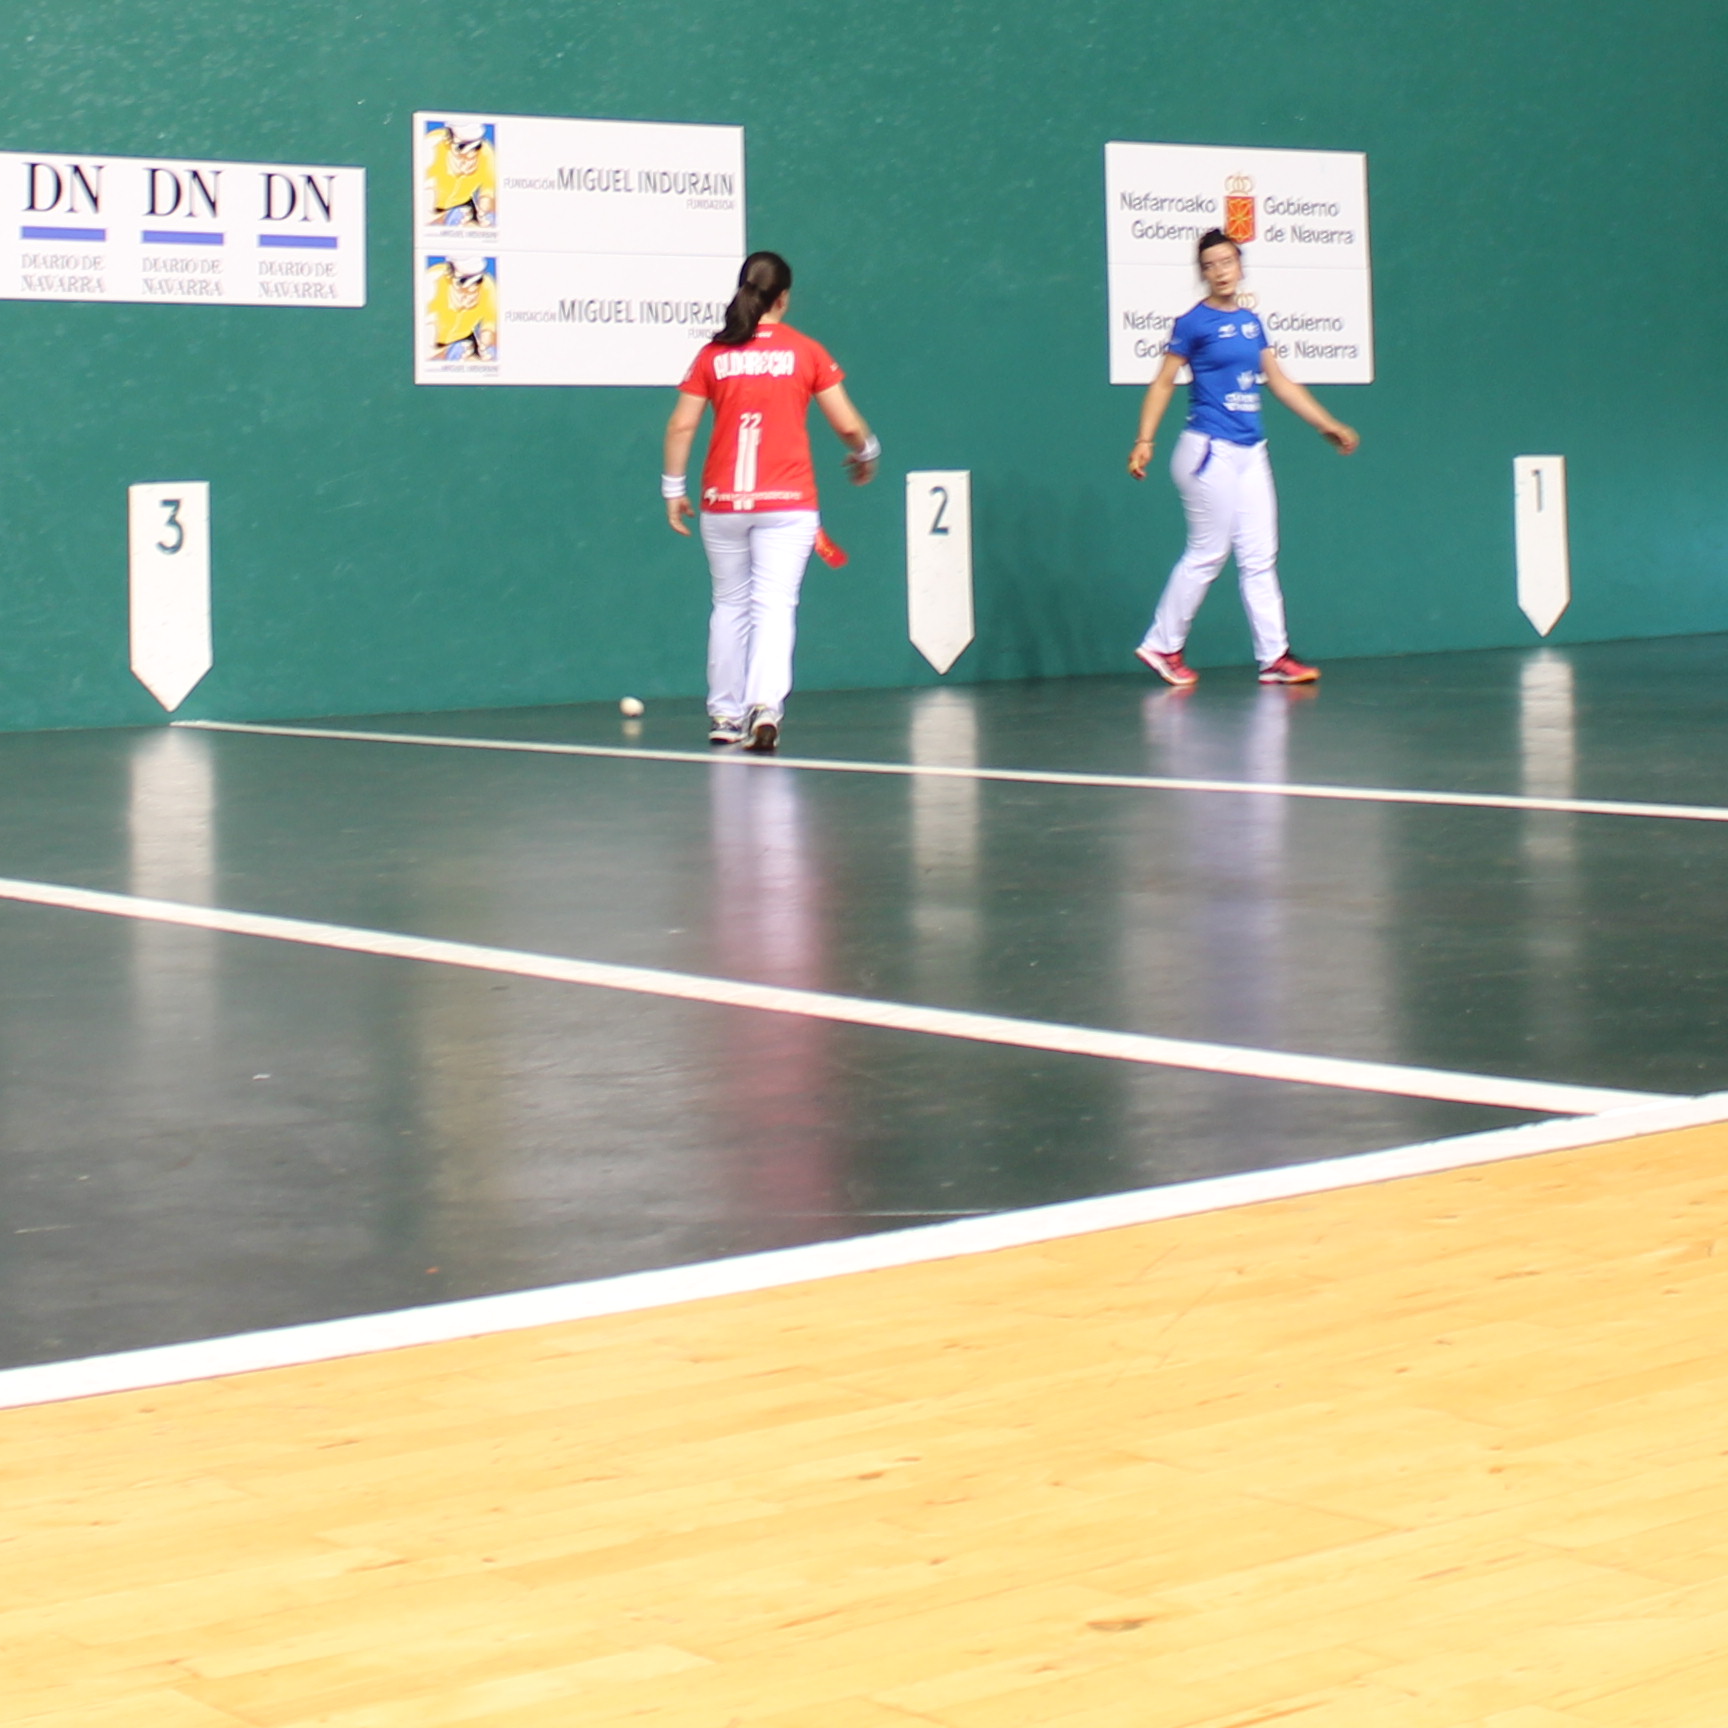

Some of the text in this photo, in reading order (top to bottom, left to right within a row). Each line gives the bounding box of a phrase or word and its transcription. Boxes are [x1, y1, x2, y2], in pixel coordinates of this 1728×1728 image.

[22, 161, 106, 213] DN
[142, 167, 224, 218] DN
[557, 167, 634, 193] MIGUEL
[638, 170, 735, 196] INDURAIN
[258, 172, 337, 223] DN
[1119, 191, 1217, 213] Nafarroako
[1263, 196, 1340, 217] Gobierno
[1131, 218, 1205, 241] Gobernu
[1264, 224, 1354, 244] de Navarra
[21, 253, 105, 272] DIARIO DE
[142, 257, 224, 275] DIARIO DE
[258, 260, 338, 278] DIARIO DE
[21, 273, 107, 293] NAVARRA
[142, 277, 224, 297] NAVARRA
[258, 280, 339, 300] NAVARRA
[558, 298, 634, 324] MIGUEL
[1267, 312, 1343, 332] Gobierno
[1294, 340, 1359, 363] Navarra
[1531, 469, 1542, 513] 1
[929, 485, 949, 536] 2
[155, 498, 184, 555] 3
